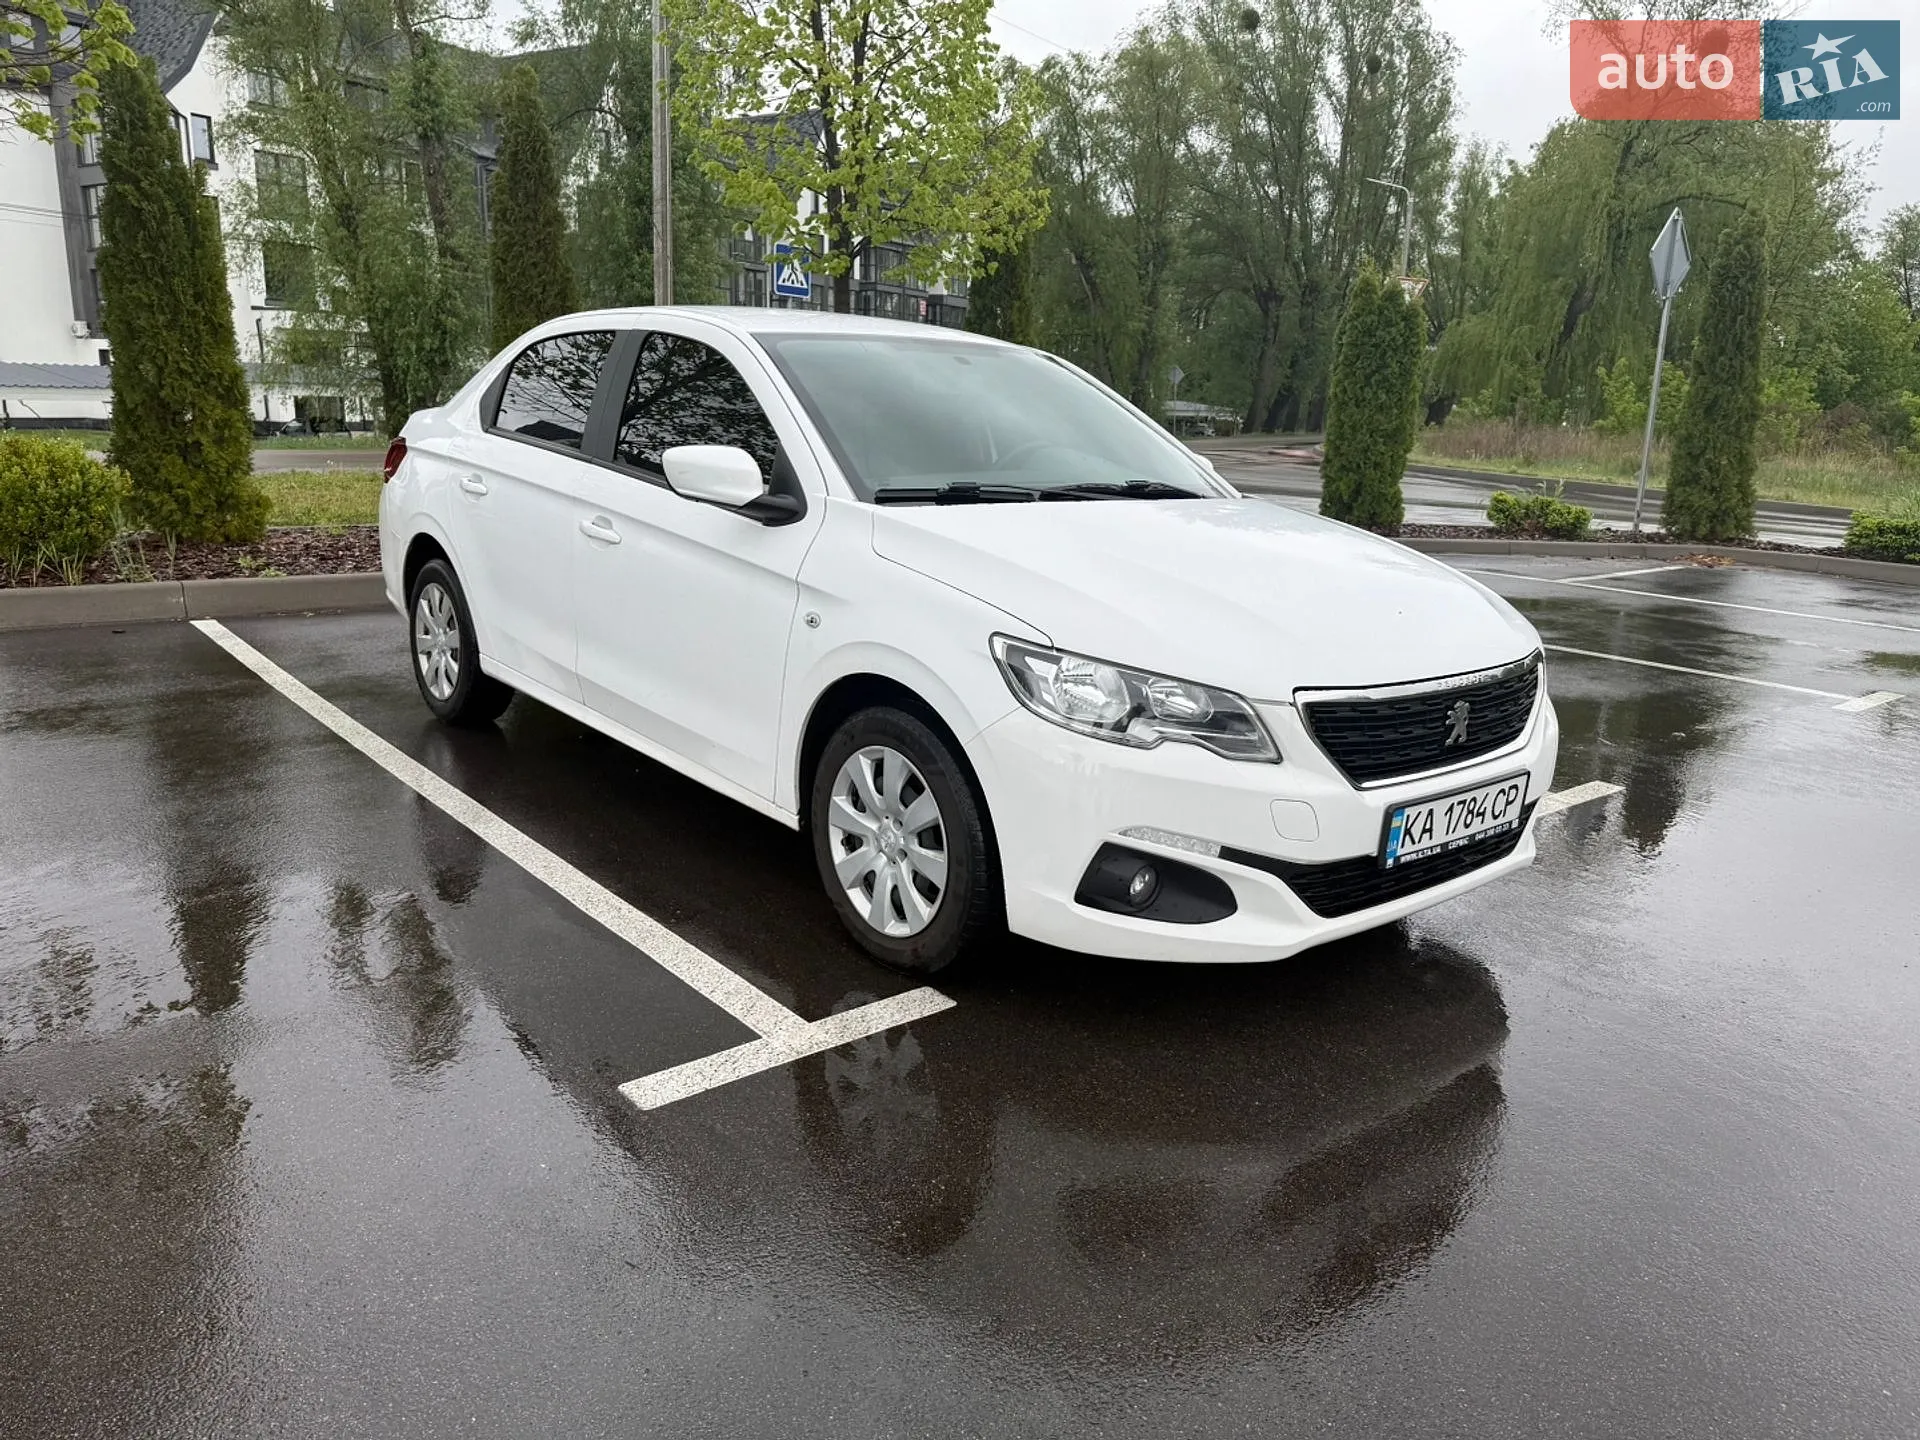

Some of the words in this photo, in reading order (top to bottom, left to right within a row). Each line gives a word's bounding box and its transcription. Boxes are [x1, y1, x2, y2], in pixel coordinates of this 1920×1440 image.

[1400, 808, 1434, 849] KA
[1444, 792, 1489, 836] 1784
[1491, 784, 1519, 820] CP
